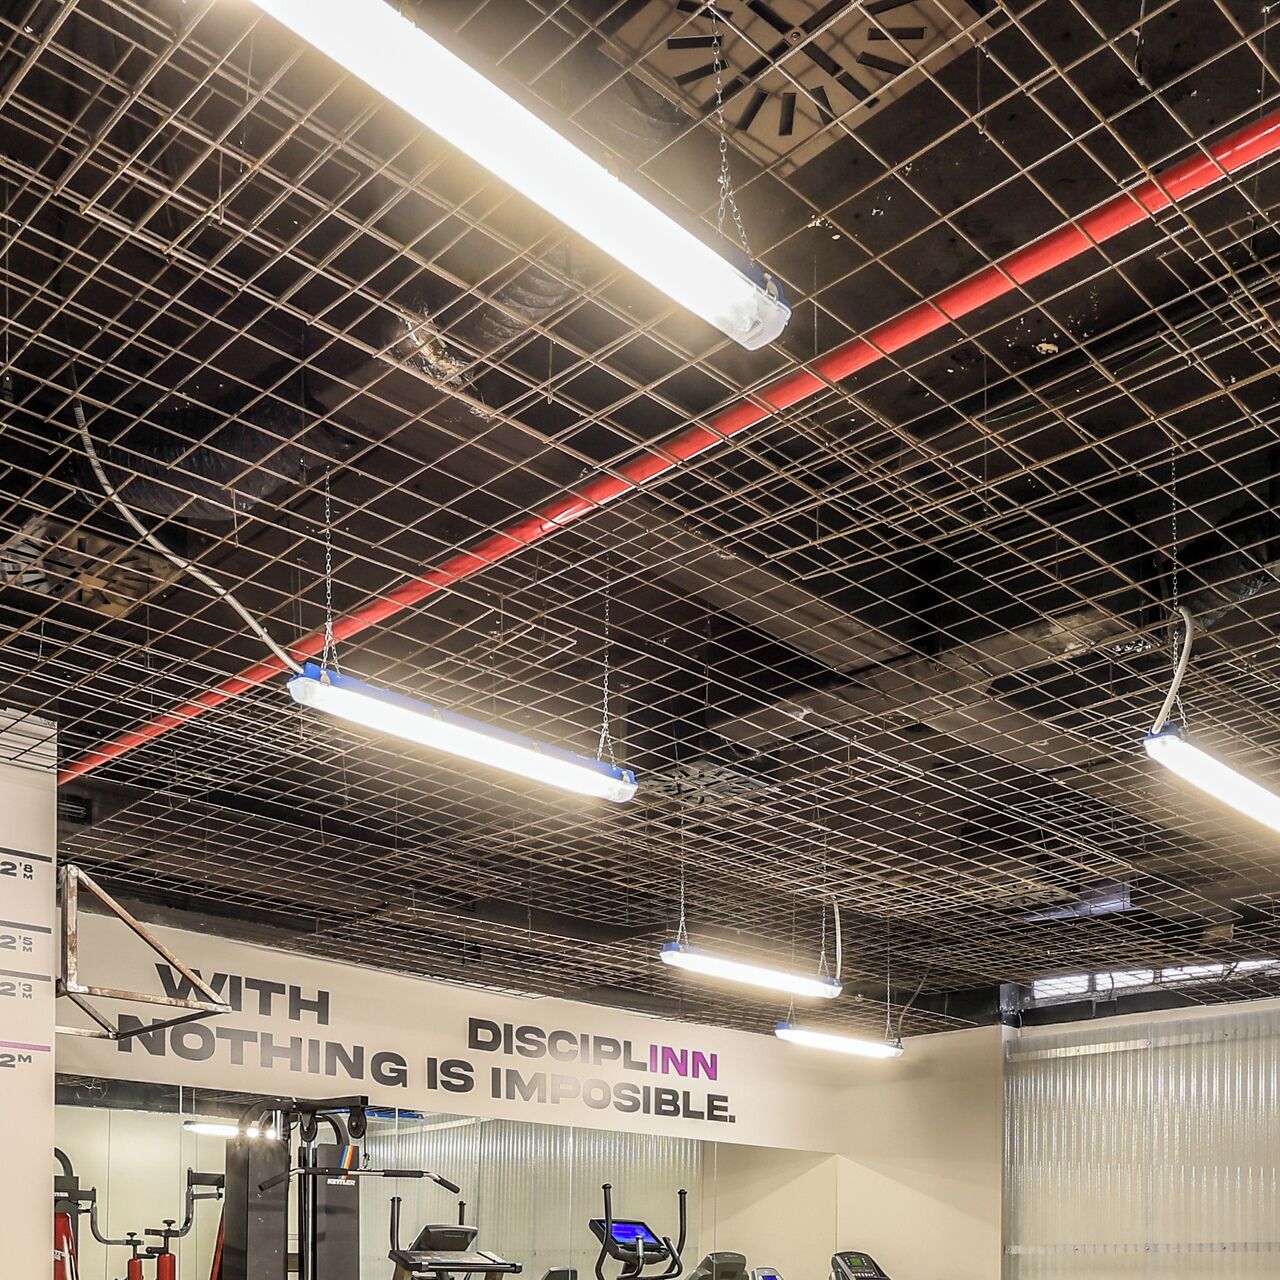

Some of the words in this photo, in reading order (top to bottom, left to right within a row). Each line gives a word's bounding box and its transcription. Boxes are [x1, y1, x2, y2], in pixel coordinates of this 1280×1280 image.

[117, 1013, 408, 1088] NOTHING
[426, 1057, 475, 1093] IS
[154, 963, 330, 1026] WITH
[467, 1017, 718, 1081] DISCIPLINN
